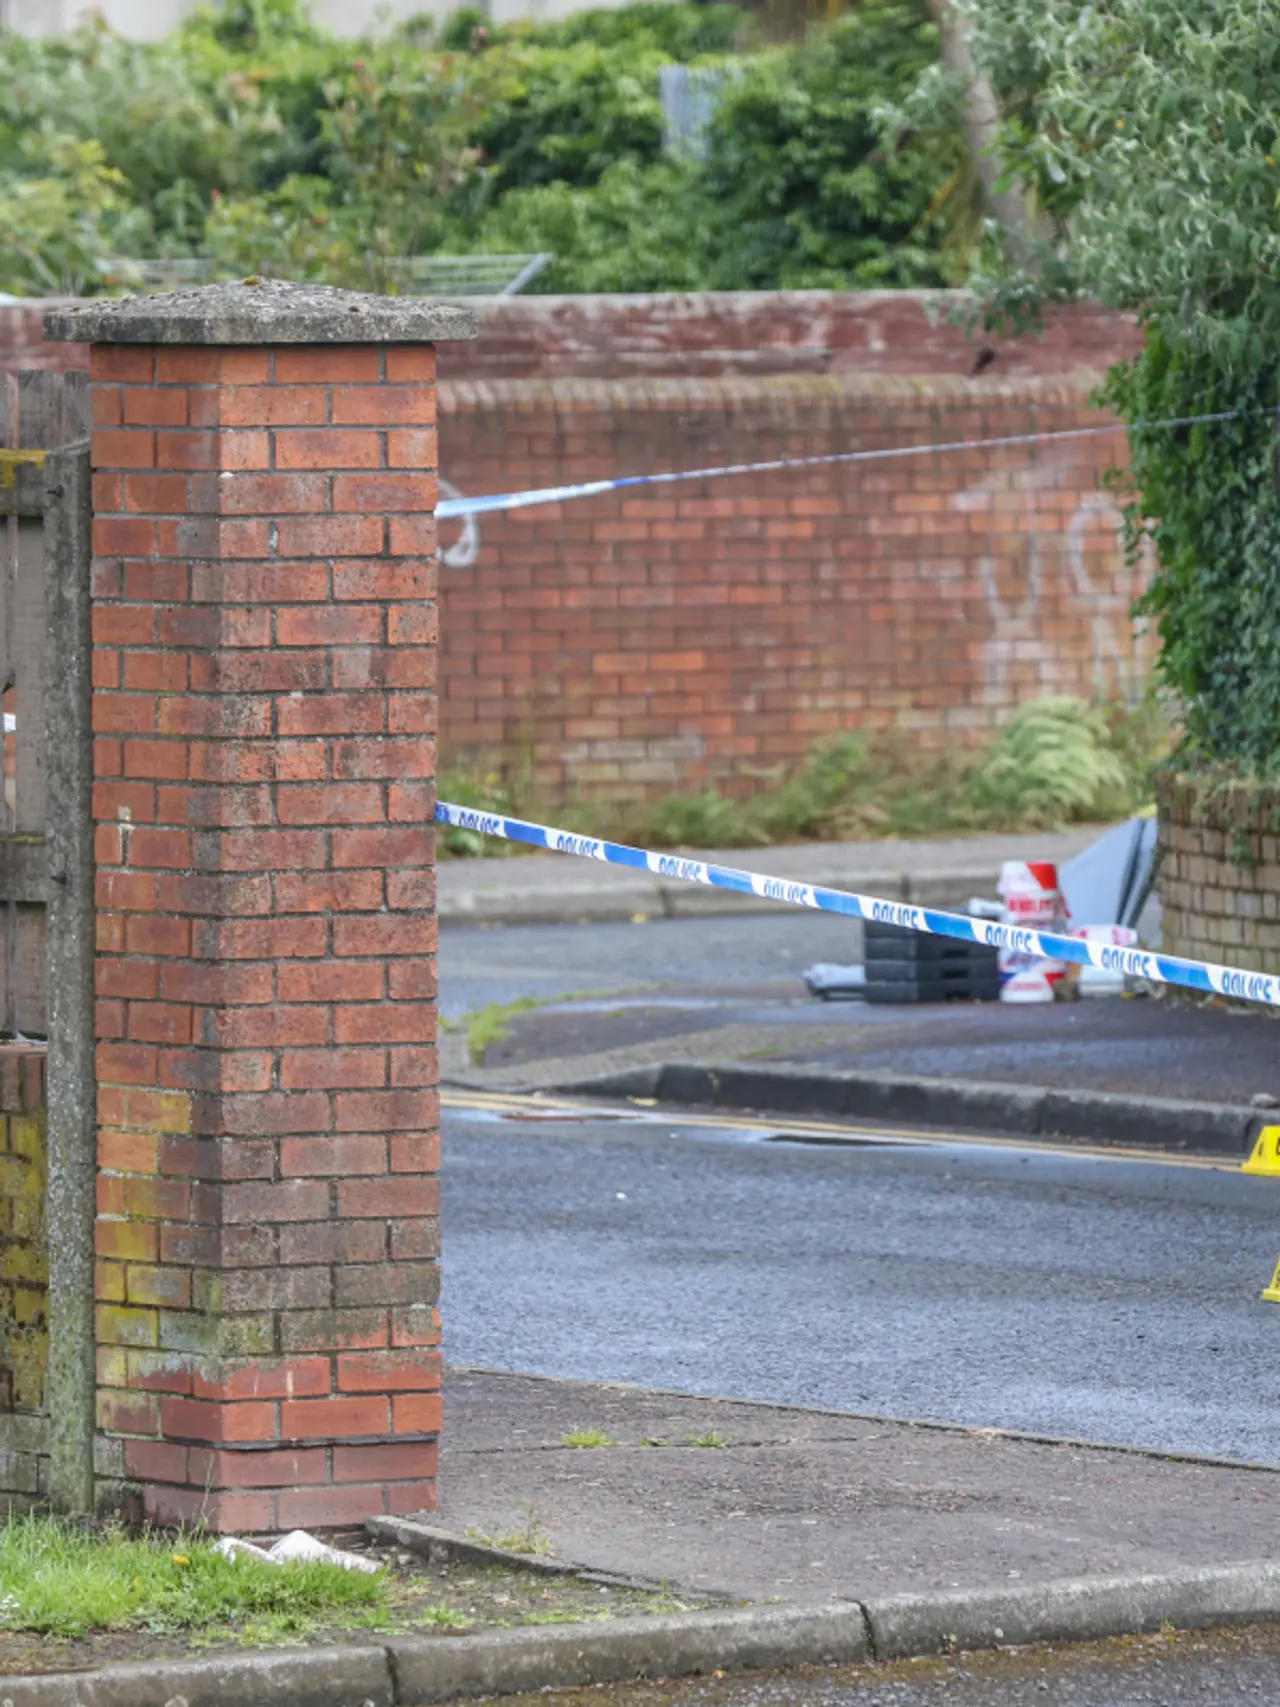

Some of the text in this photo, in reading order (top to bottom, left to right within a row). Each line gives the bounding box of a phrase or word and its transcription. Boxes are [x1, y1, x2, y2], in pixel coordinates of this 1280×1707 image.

[985, 925, 1032, 952] POLICE
[1101, 947, 1149, 976] POLICE
[1222, 971, 1273, 1002] POLICE
